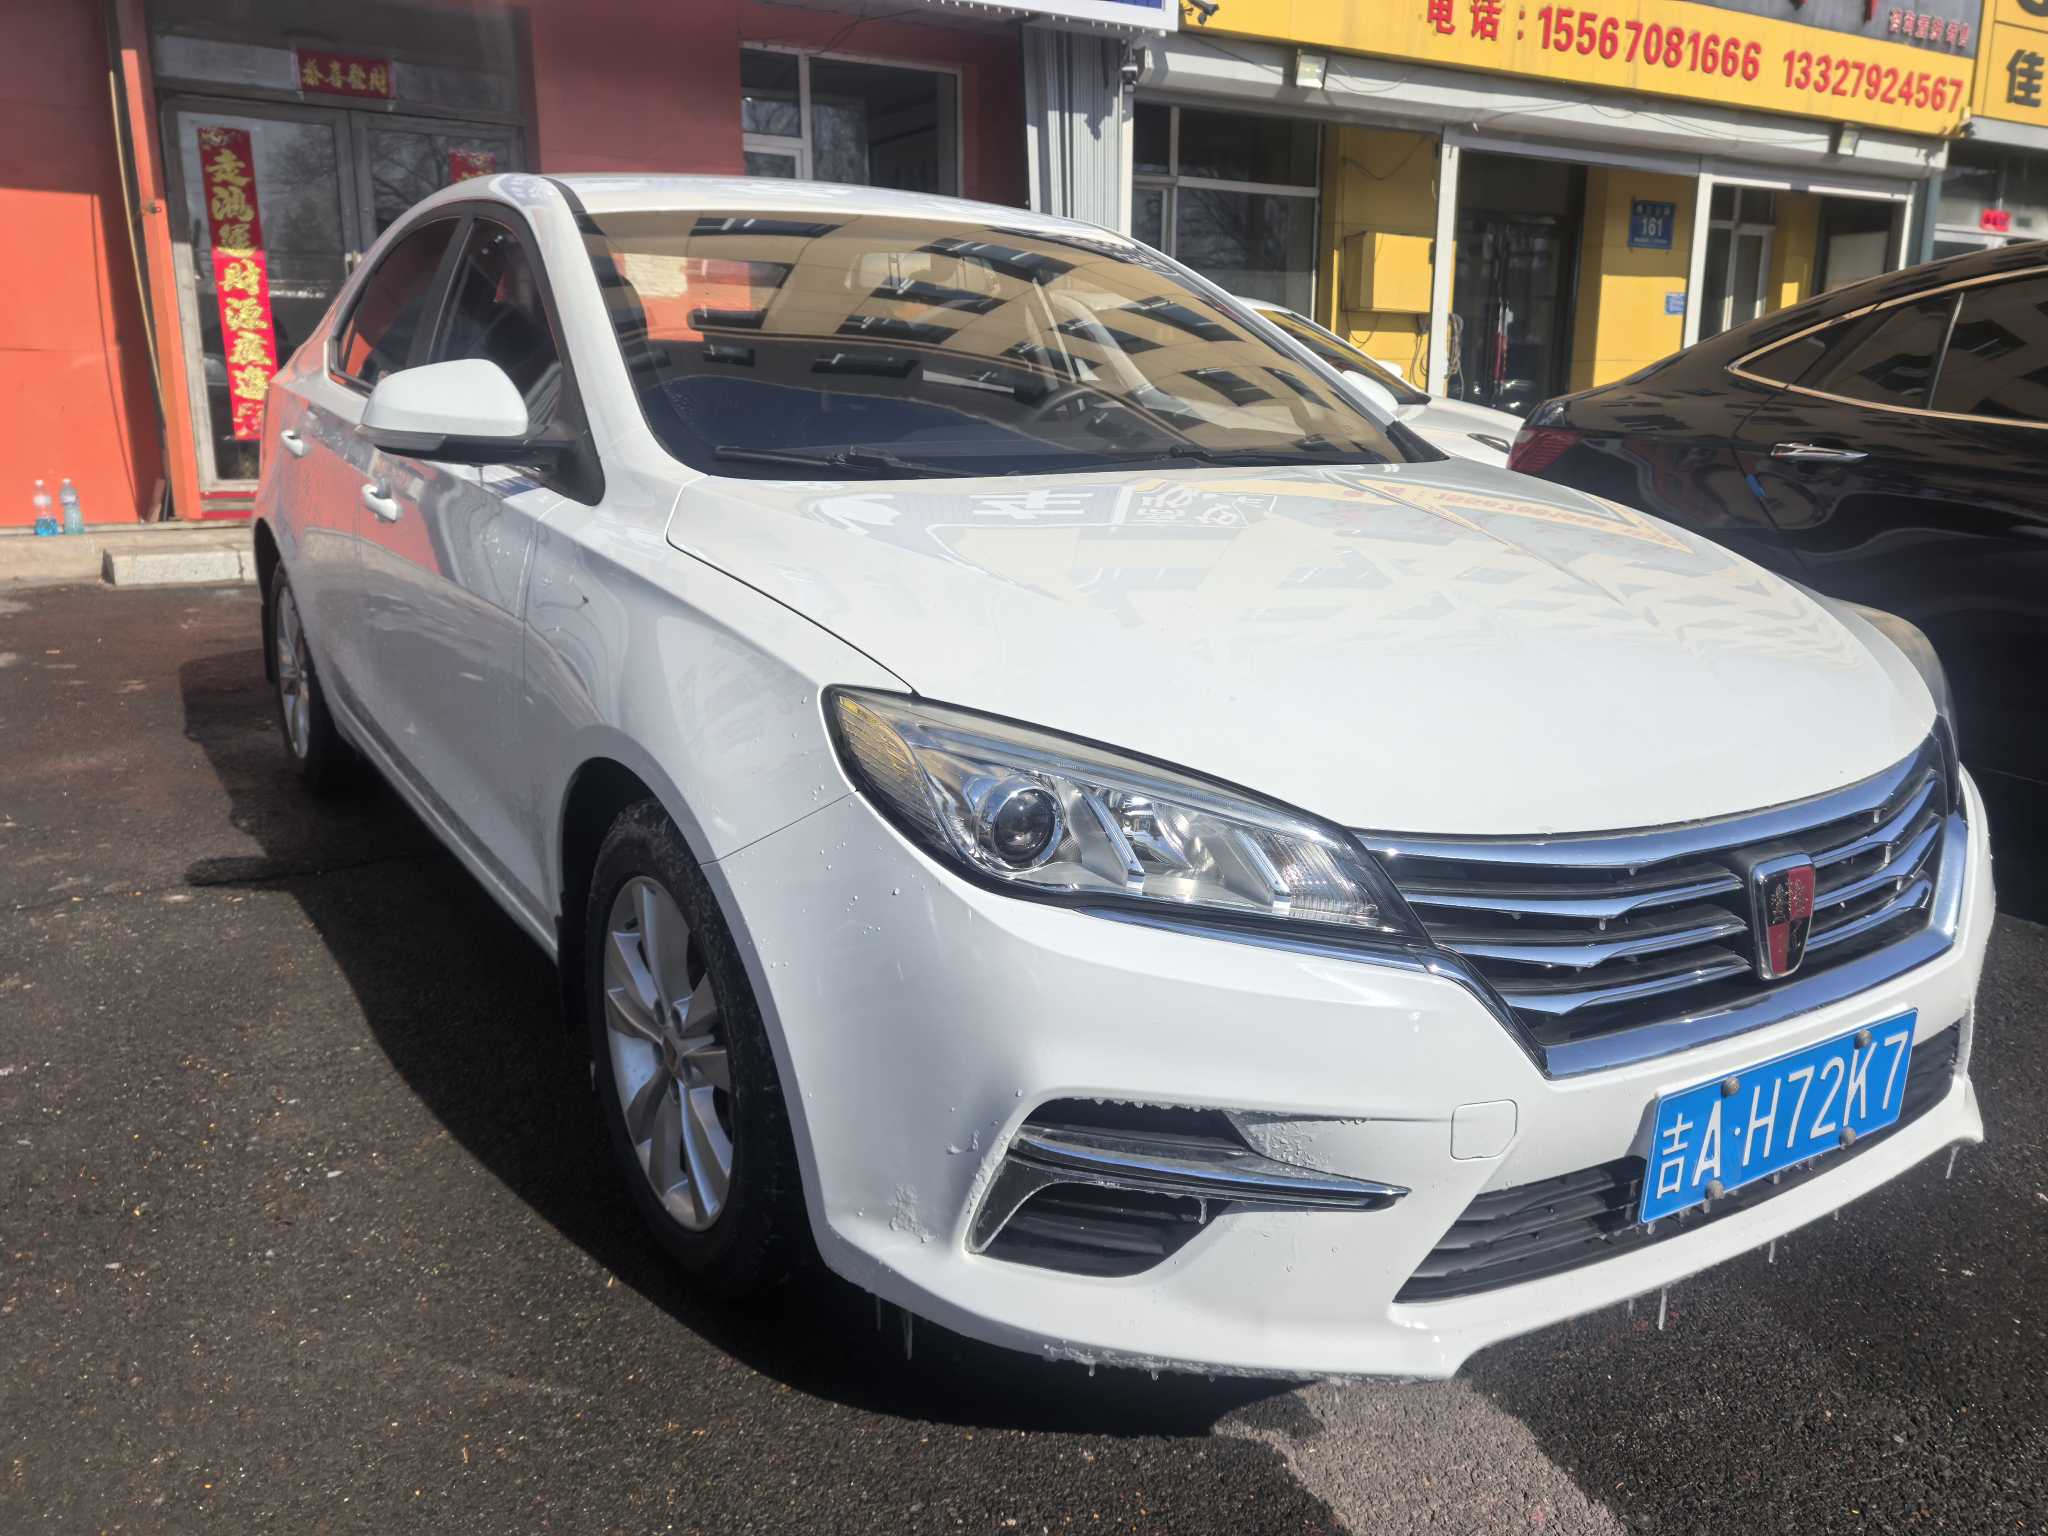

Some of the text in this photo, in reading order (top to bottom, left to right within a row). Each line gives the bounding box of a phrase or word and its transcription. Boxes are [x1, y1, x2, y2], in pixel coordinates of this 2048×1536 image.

[1538, 6, 1762, 81] 15567081666
[1783, 50, 1964, 112] 13327924567
[2006, 49, 2045, 108] 佳
[1642, 217, 1664, 237] 161
